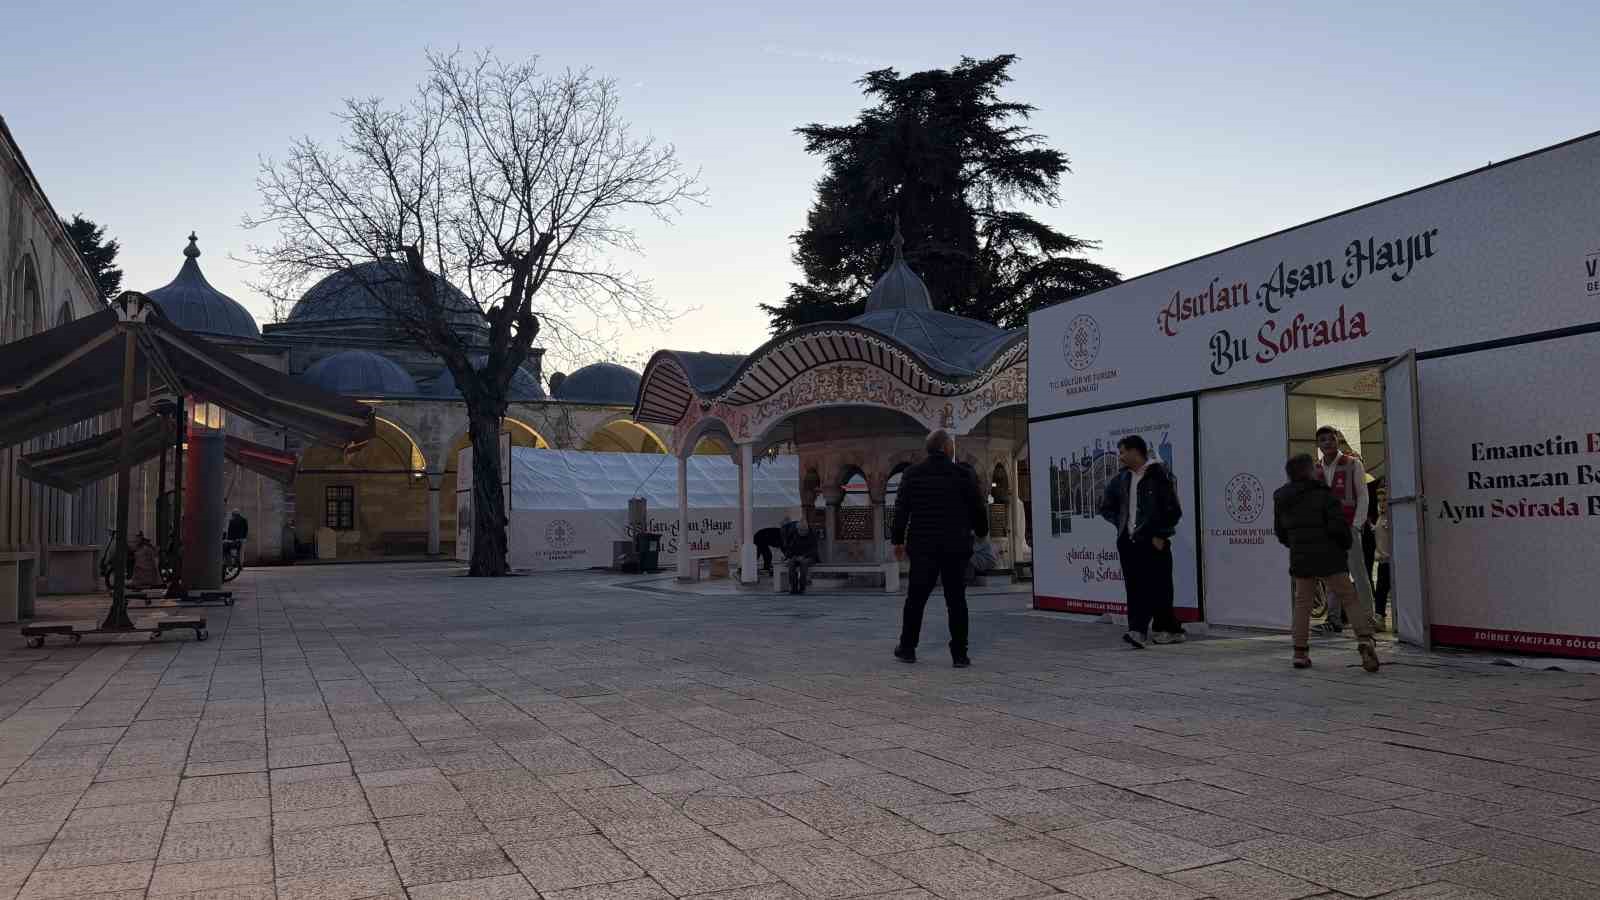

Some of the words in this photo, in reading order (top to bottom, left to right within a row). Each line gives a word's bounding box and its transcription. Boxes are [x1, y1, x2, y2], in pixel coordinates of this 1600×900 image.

[1157, 277, 1250, 336] Asırları
[1256, 259, 1335, 313] Aşan
[1341, 228, 1439, 288] Hayır
[1209, 329, 1249, 375] Bu
[1255, 304, 1370, 363] Sofrada
[1471, 434, 1579, 461] Emanetin
[1467, 468, 1569, 490] Ramazan
[1438, 500, 1485, 524] Aynı
[1490, 496, 1580, 518] Sofrada
[1512, 634, 1562, 647] VAKIFLAR
